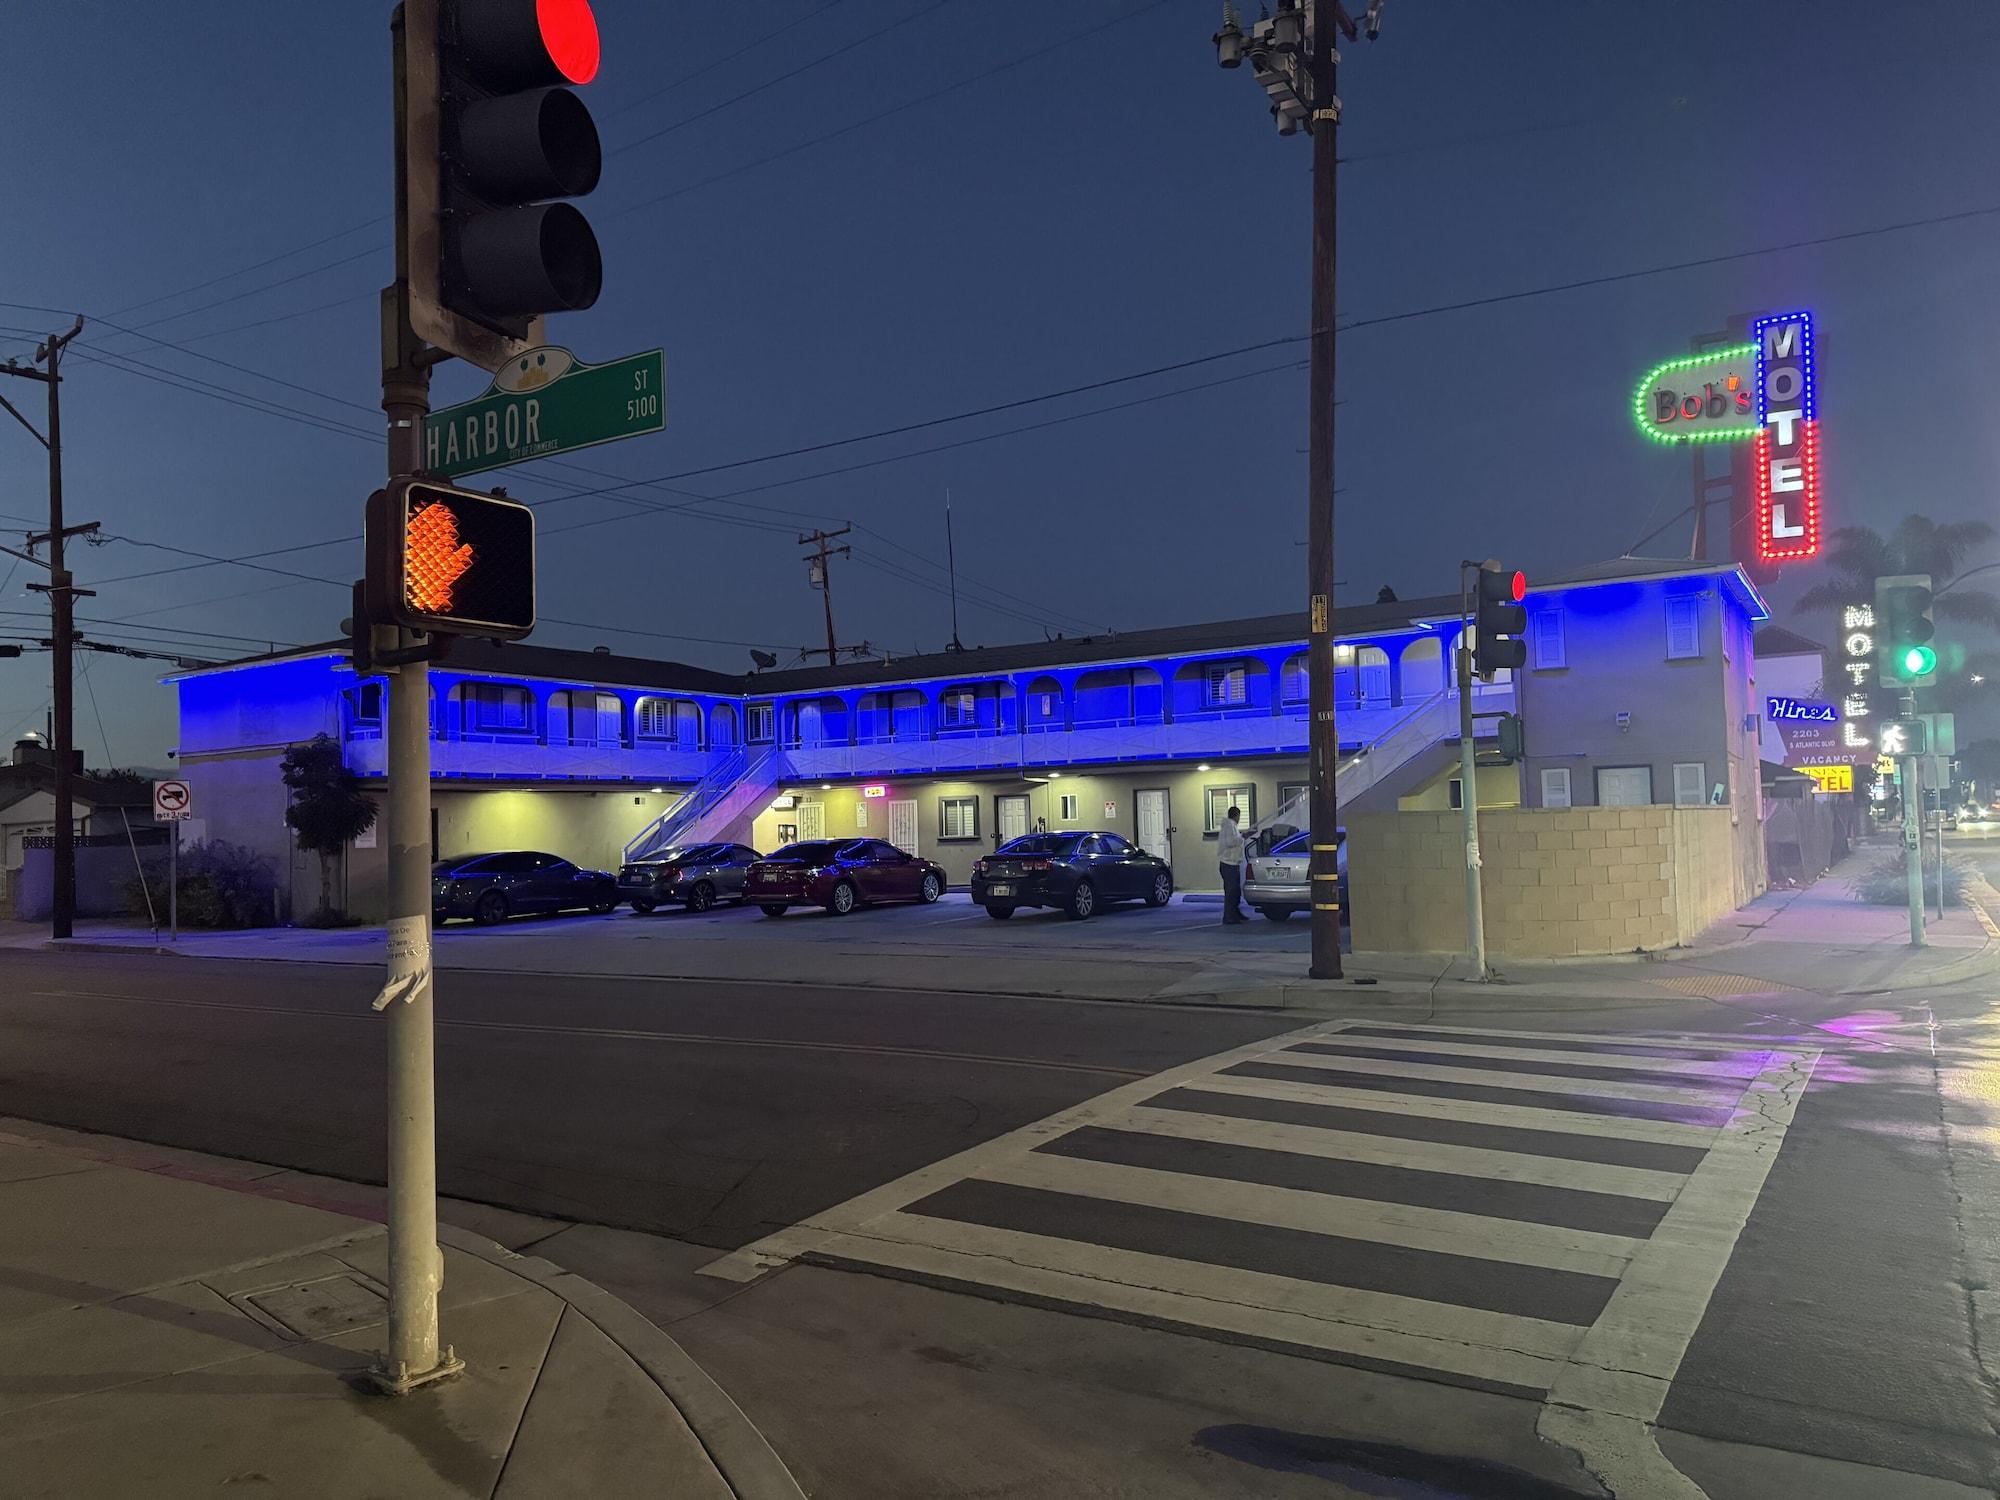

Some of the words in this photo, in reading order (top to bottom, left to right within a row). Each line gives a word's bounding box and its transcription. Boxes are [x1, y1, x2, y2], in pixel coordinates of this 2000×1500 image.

[634, 369, 648, 391] ST
[627, 395, 657, 421] 5100
[1653, 376, 1753, 425] Bob's
[427, 399, 542, 470] HARBOR
[1765, 323, 1804, 538] MOTEL
[1844, 604, 1874, 746] MOTEL
[1769, 698, 1836, 721] Hines
[1792, 729, 1820, 738] 2203
[1795, 741, 1820, 749] ATLANTIC
[1821, 740, 1836, 748] BLVD
[1802, 755, 1856, 764] VACANCY
